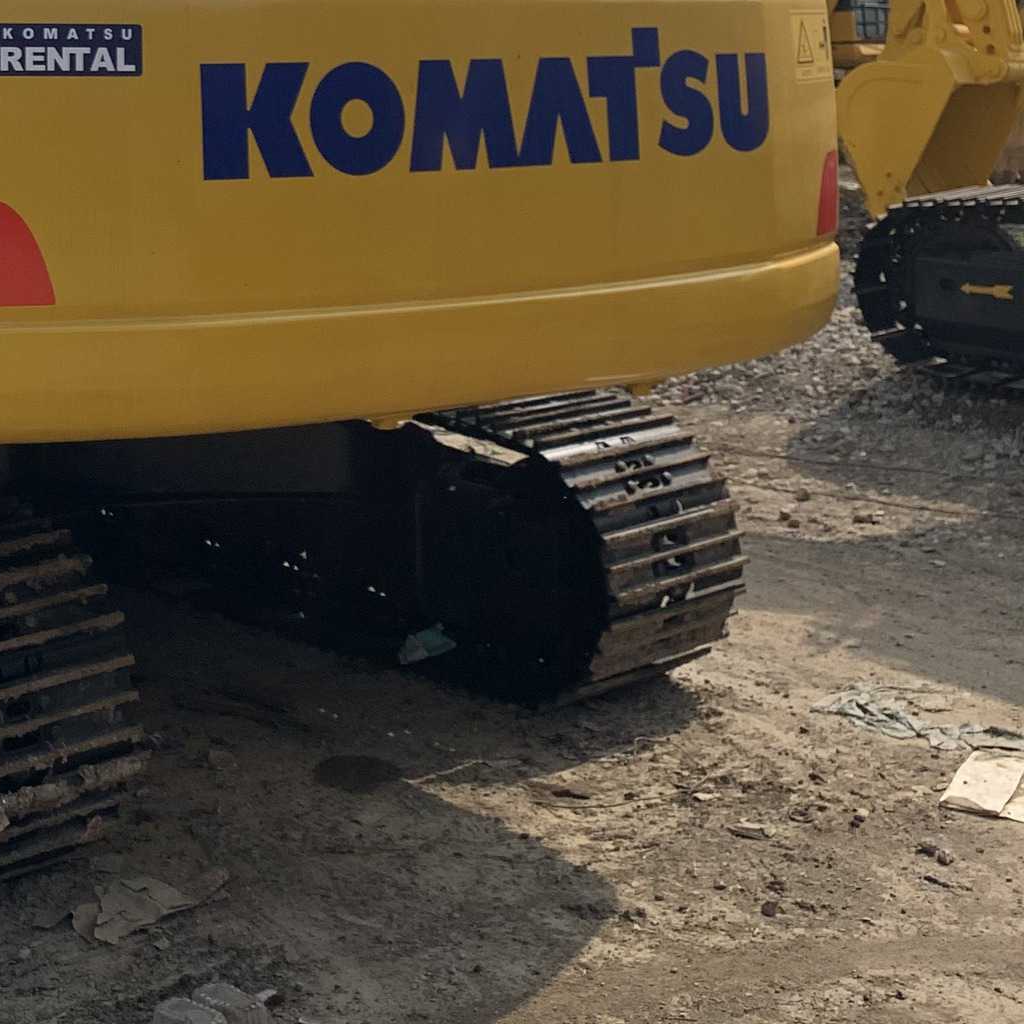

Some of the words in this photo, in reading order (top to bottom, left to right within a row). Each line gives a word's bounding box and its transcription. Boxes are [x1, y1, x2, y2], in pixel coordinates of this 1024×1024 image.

[2, 27, 133, 40] KOMATSU
[0, 46, 136, 72] RENTAL
[200, 27, 770, 180] KOMATSU
